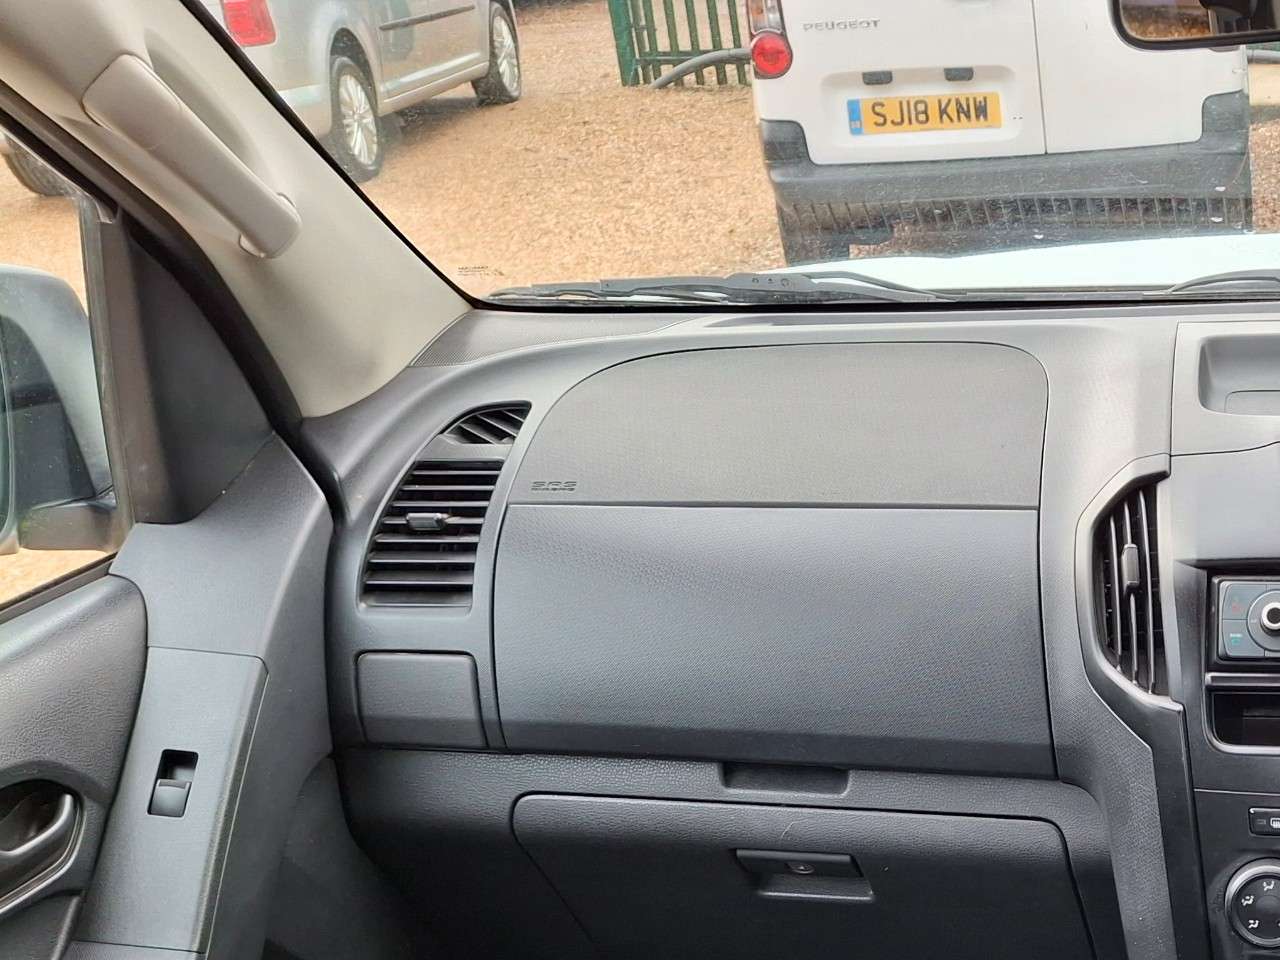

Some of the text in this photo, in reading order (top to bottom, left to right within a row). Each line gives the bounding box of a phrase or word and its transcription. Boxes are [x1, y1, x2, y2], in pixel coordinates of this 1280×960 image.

[802, 19, 881, 32] PEUGEOT
[871, 96, 989, 128] SJ18 KNW
